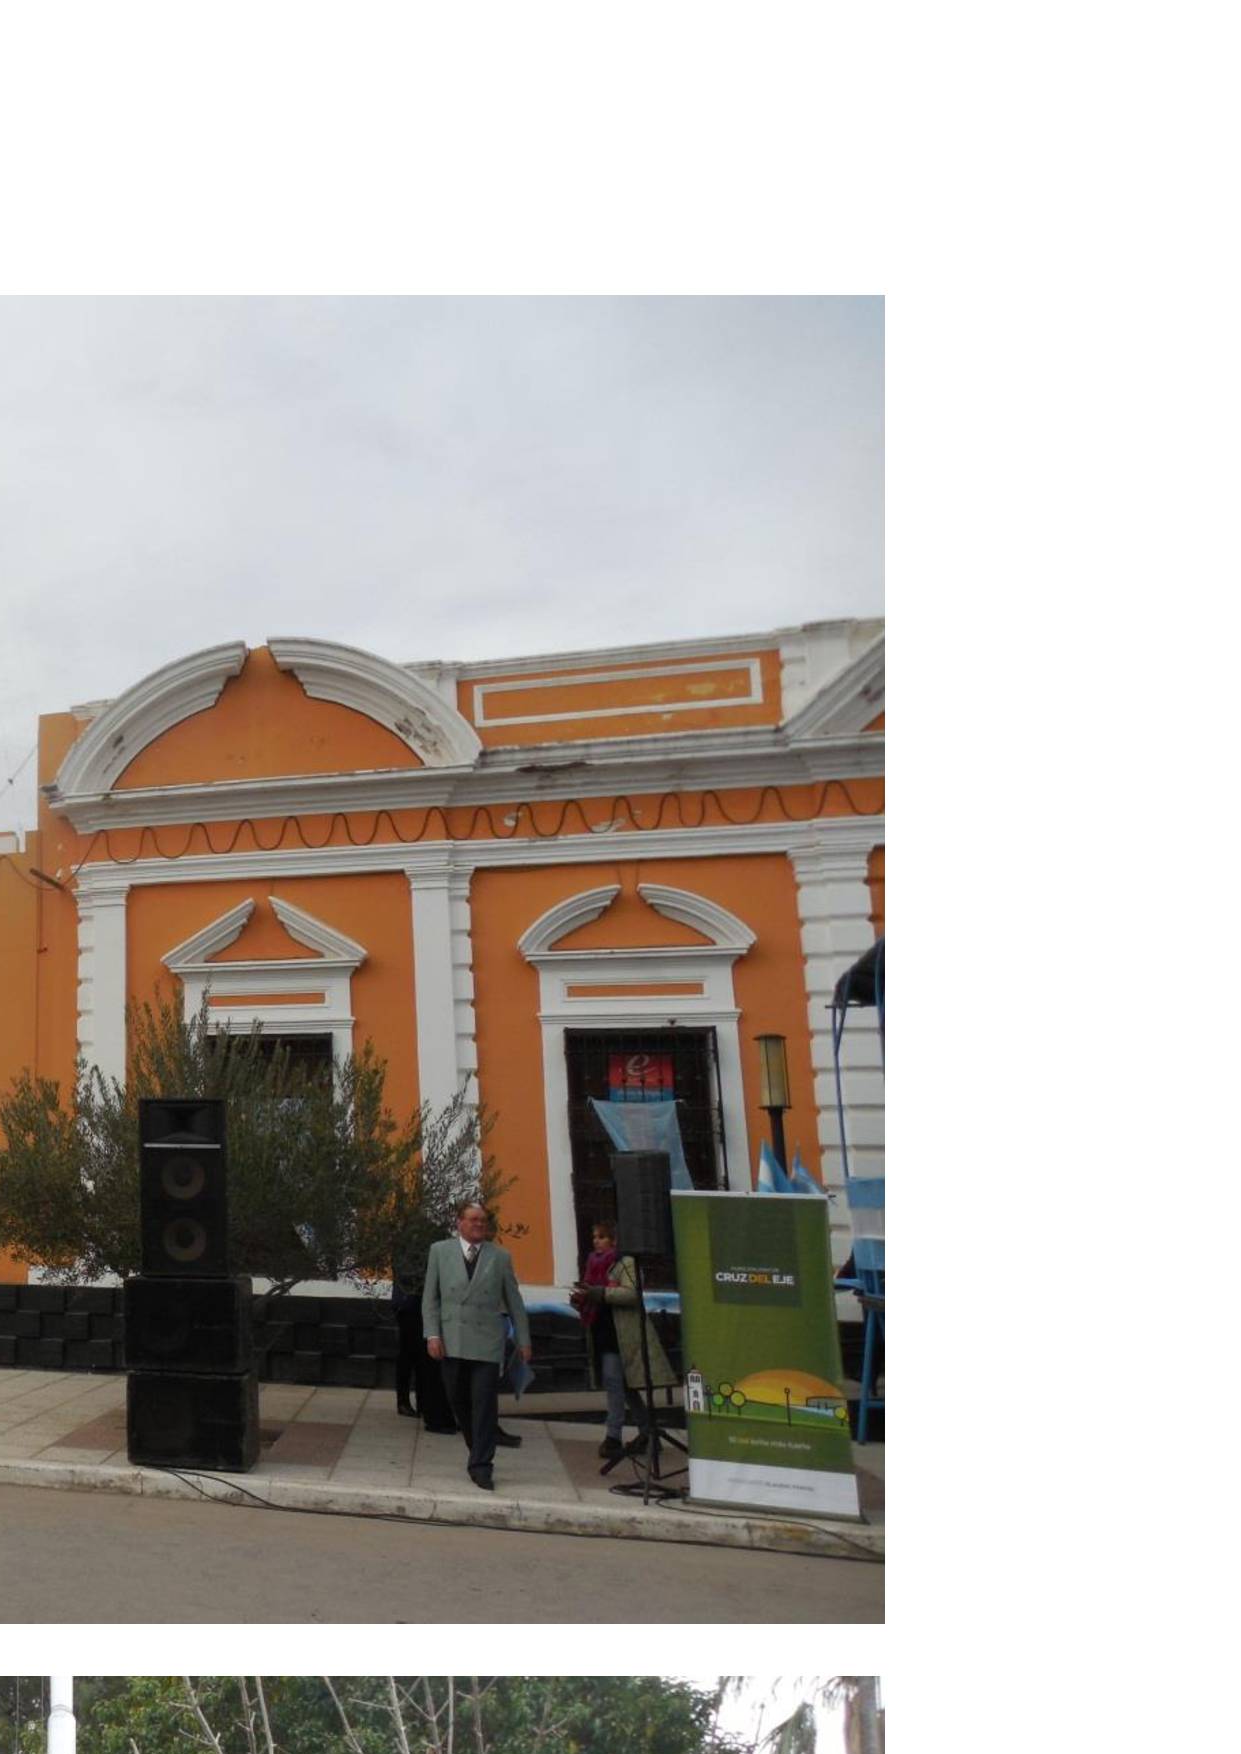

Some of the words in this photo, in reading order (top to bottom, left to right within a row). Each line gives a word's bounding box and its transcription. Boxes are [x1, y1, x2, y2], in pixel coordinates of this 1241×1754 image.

[715, 1272, 748, 1283] CRUZ
[749, 1273, 771, 1284] DEL
[772, 1274, 795, 1285] EJE
